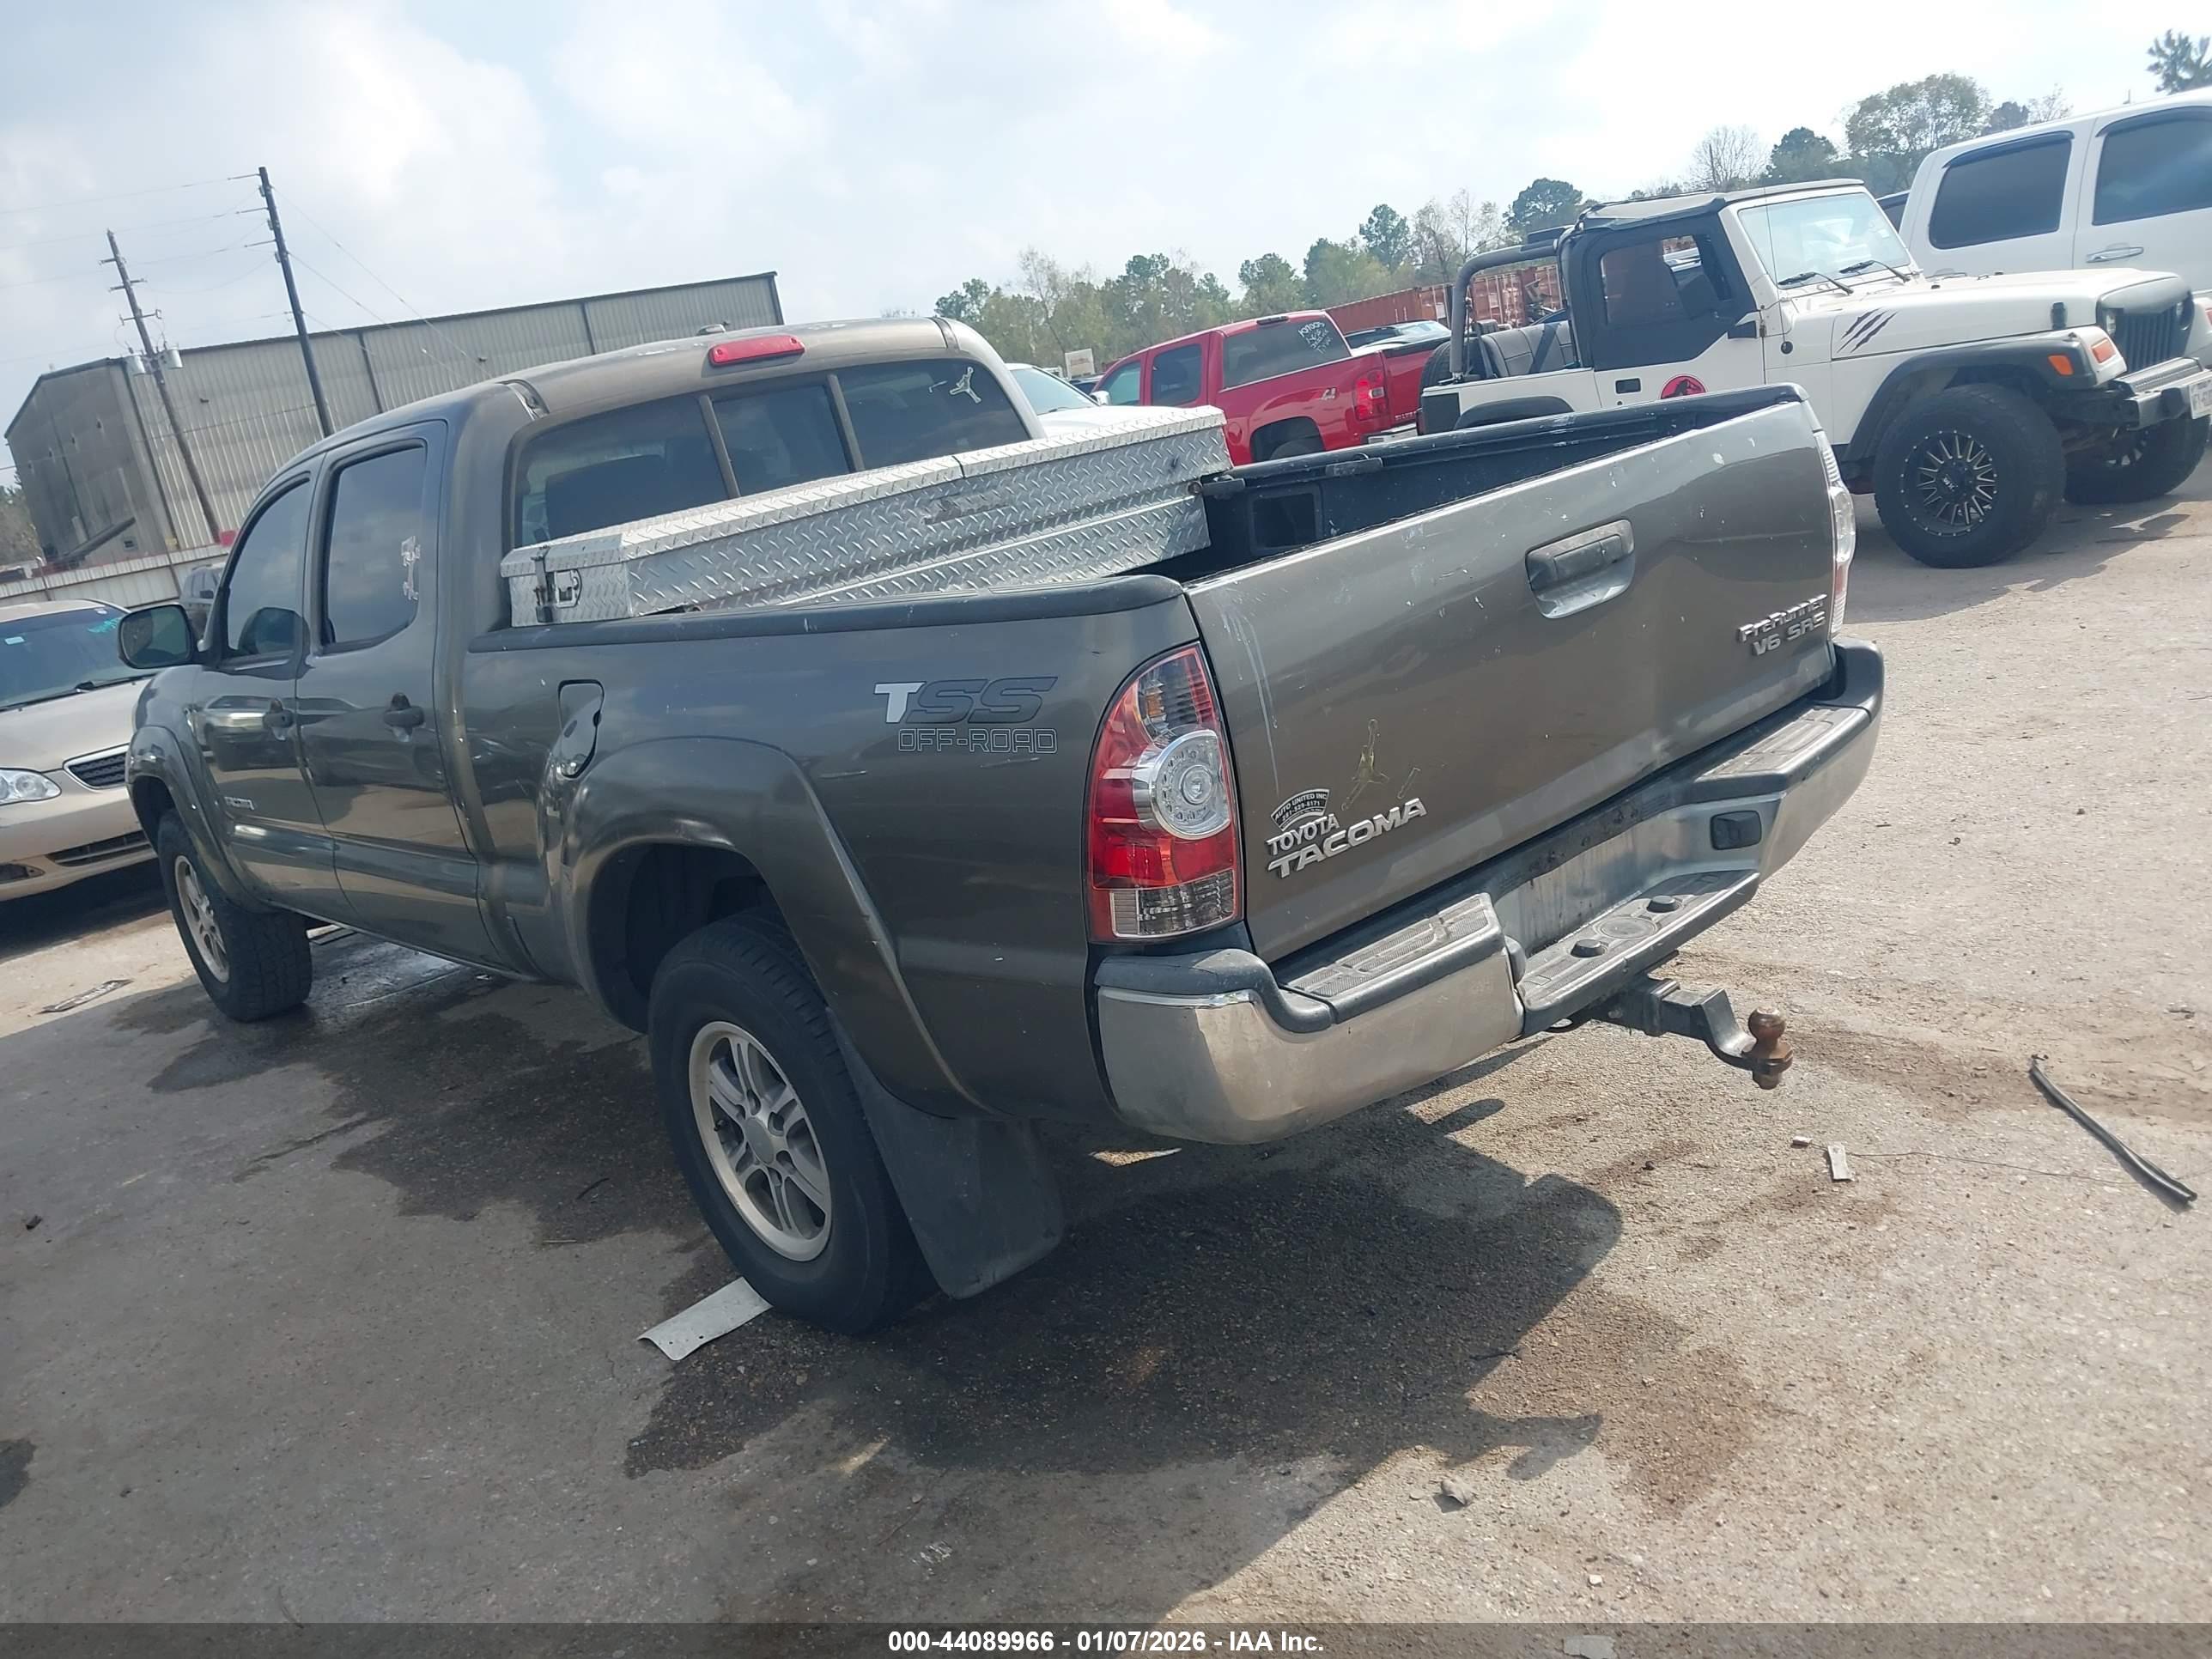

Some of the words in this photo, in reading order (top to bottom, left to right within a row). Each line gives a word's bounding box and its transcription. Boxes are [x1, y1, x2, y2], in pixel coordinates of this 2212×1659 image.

[1786, 611, 1826, 641] SR5
[1753, 633, 1781, 656] V6
[872, 676, 1059, 725] TSS
[898, 728, 1057, 754] OFF-ROAD
[1274, 803, 1291, 821] AUTO
[1291, 793, 1315, 805] UNITED
[1265, 813, 1340, 856] TOYOTA
[1267, 798, 1428, 878] TACOMA
